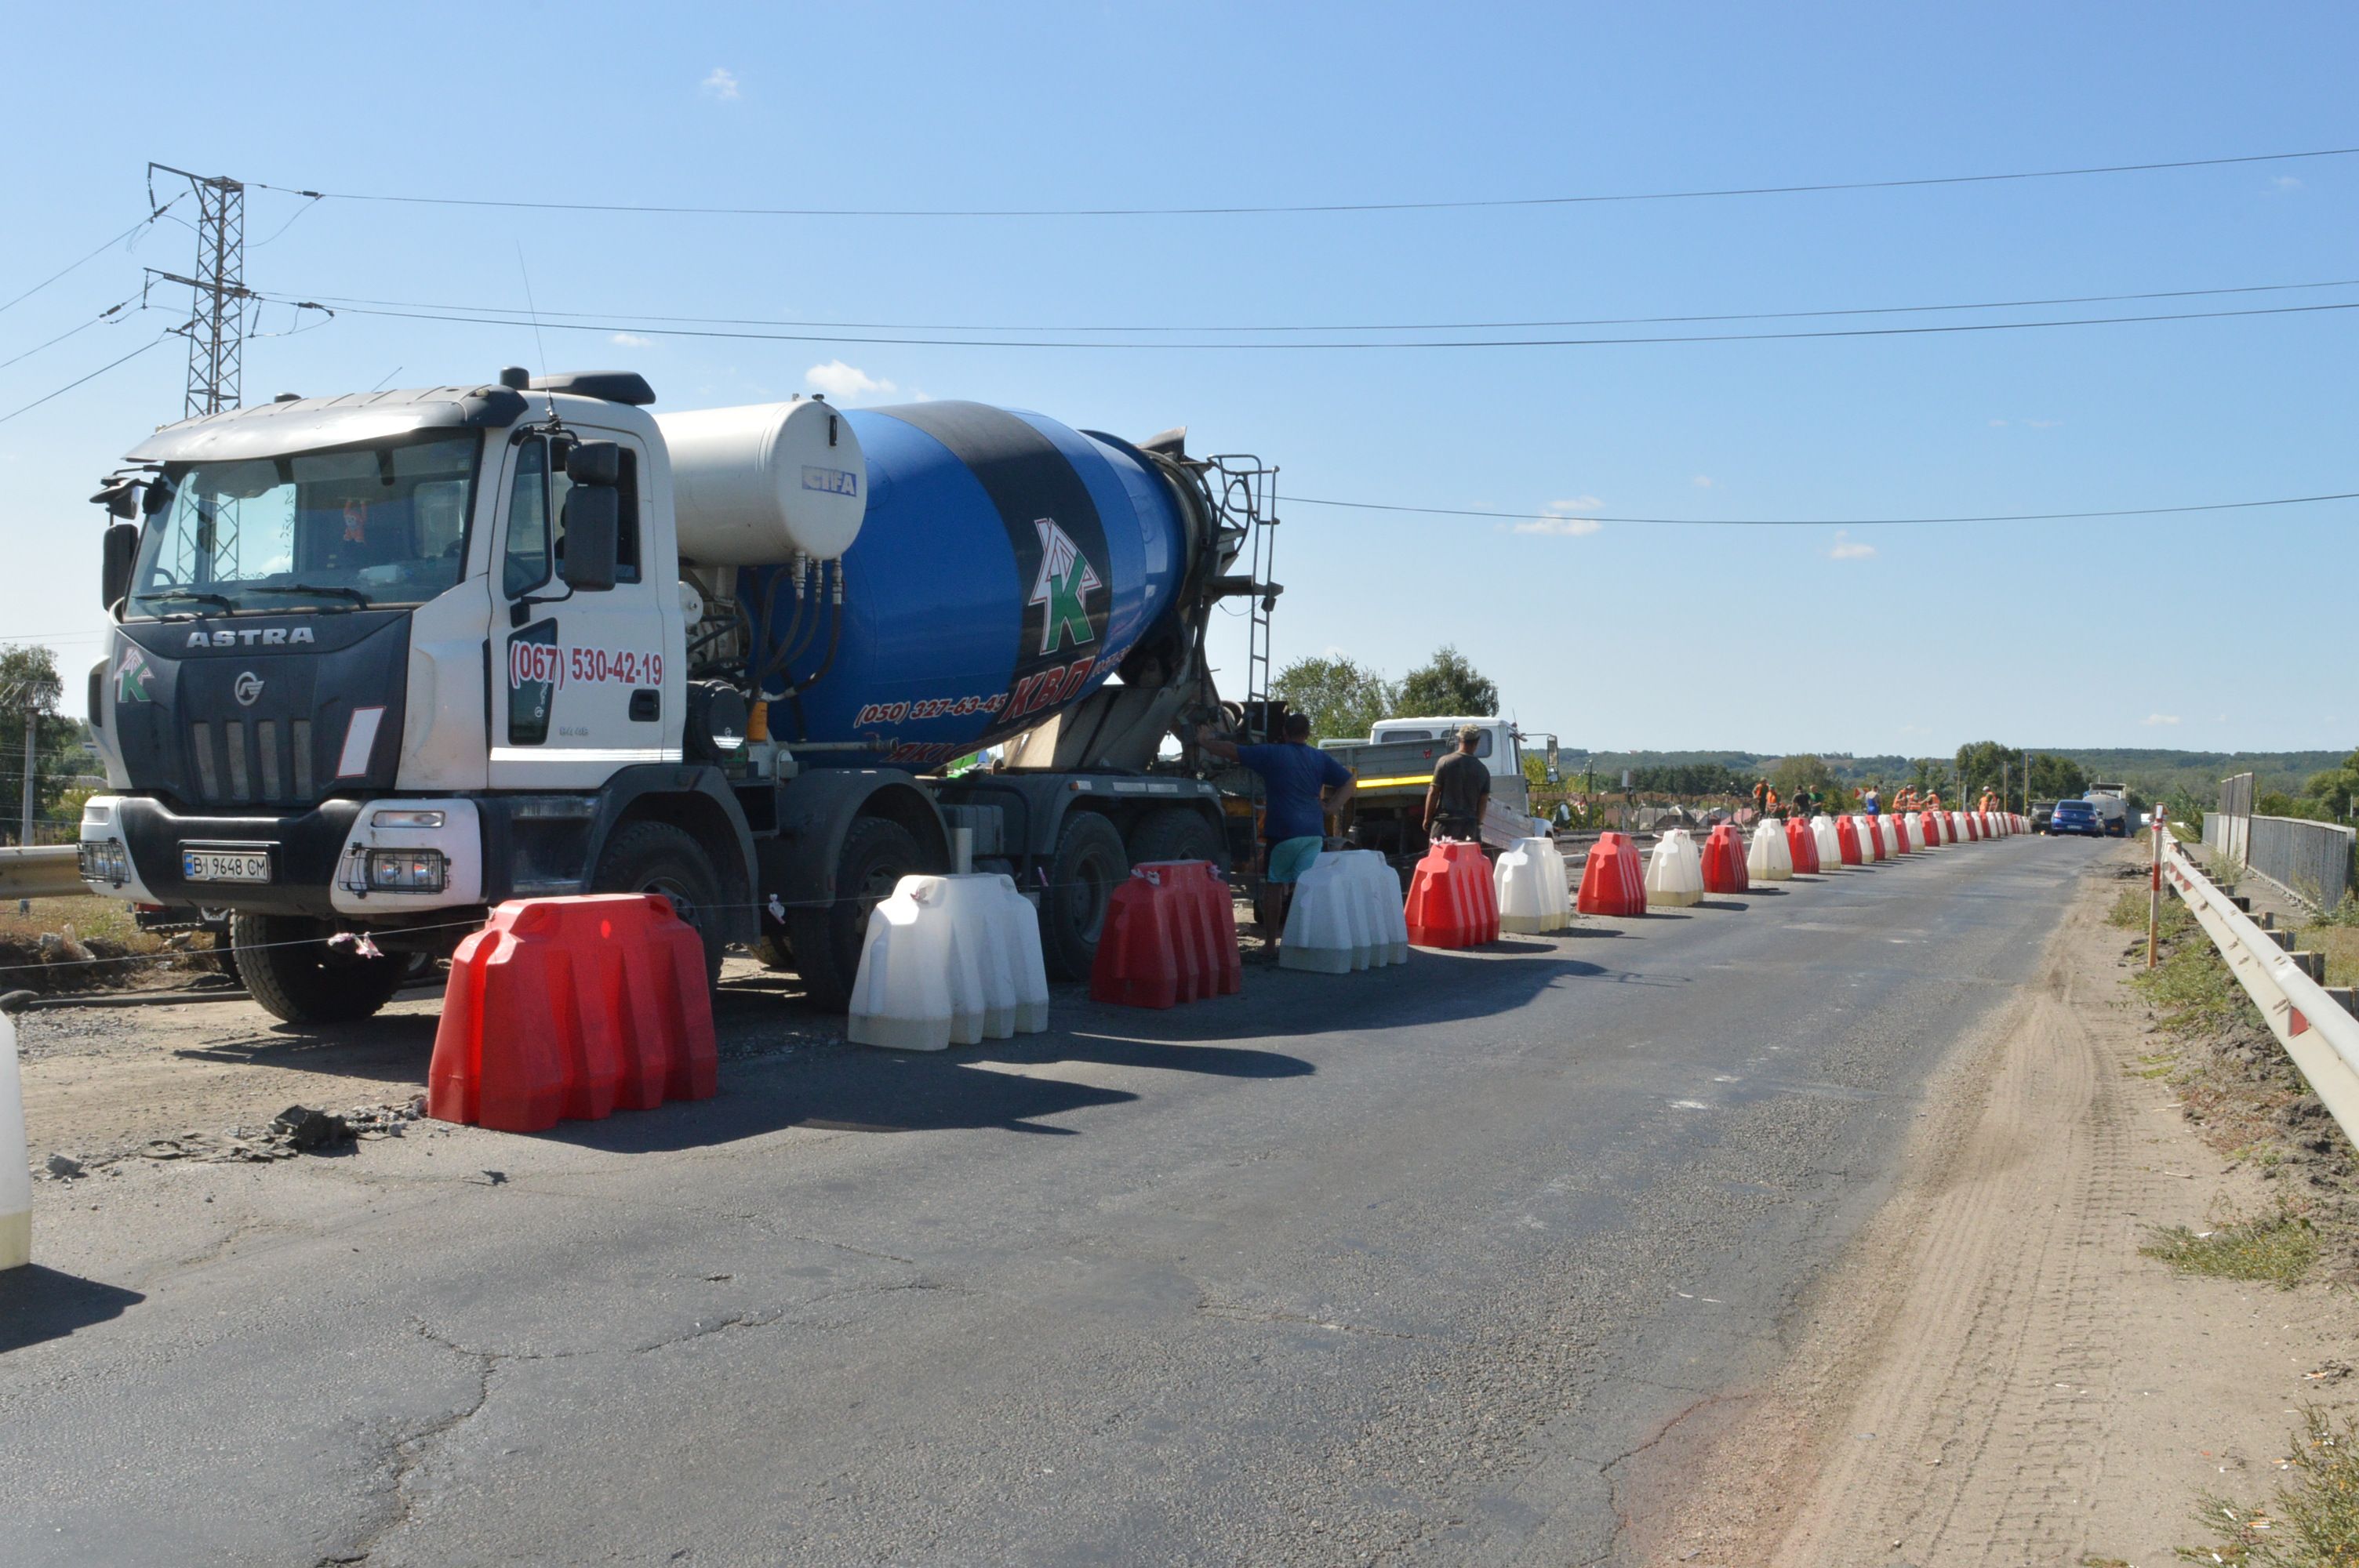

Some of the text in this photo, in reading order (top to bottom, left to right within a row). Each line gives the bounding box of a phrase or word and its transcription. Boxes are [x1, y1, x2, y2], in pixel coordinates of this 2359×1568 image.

[187, 628, 314, 648] ASTRA
[511, 641, 565, 692] (067)
[571, 648, 663, 687] 530-42-19
[853, 693, 1009, 728] (050) 327-63-45
[193, 857, 266, 877] BI 9648 CM
